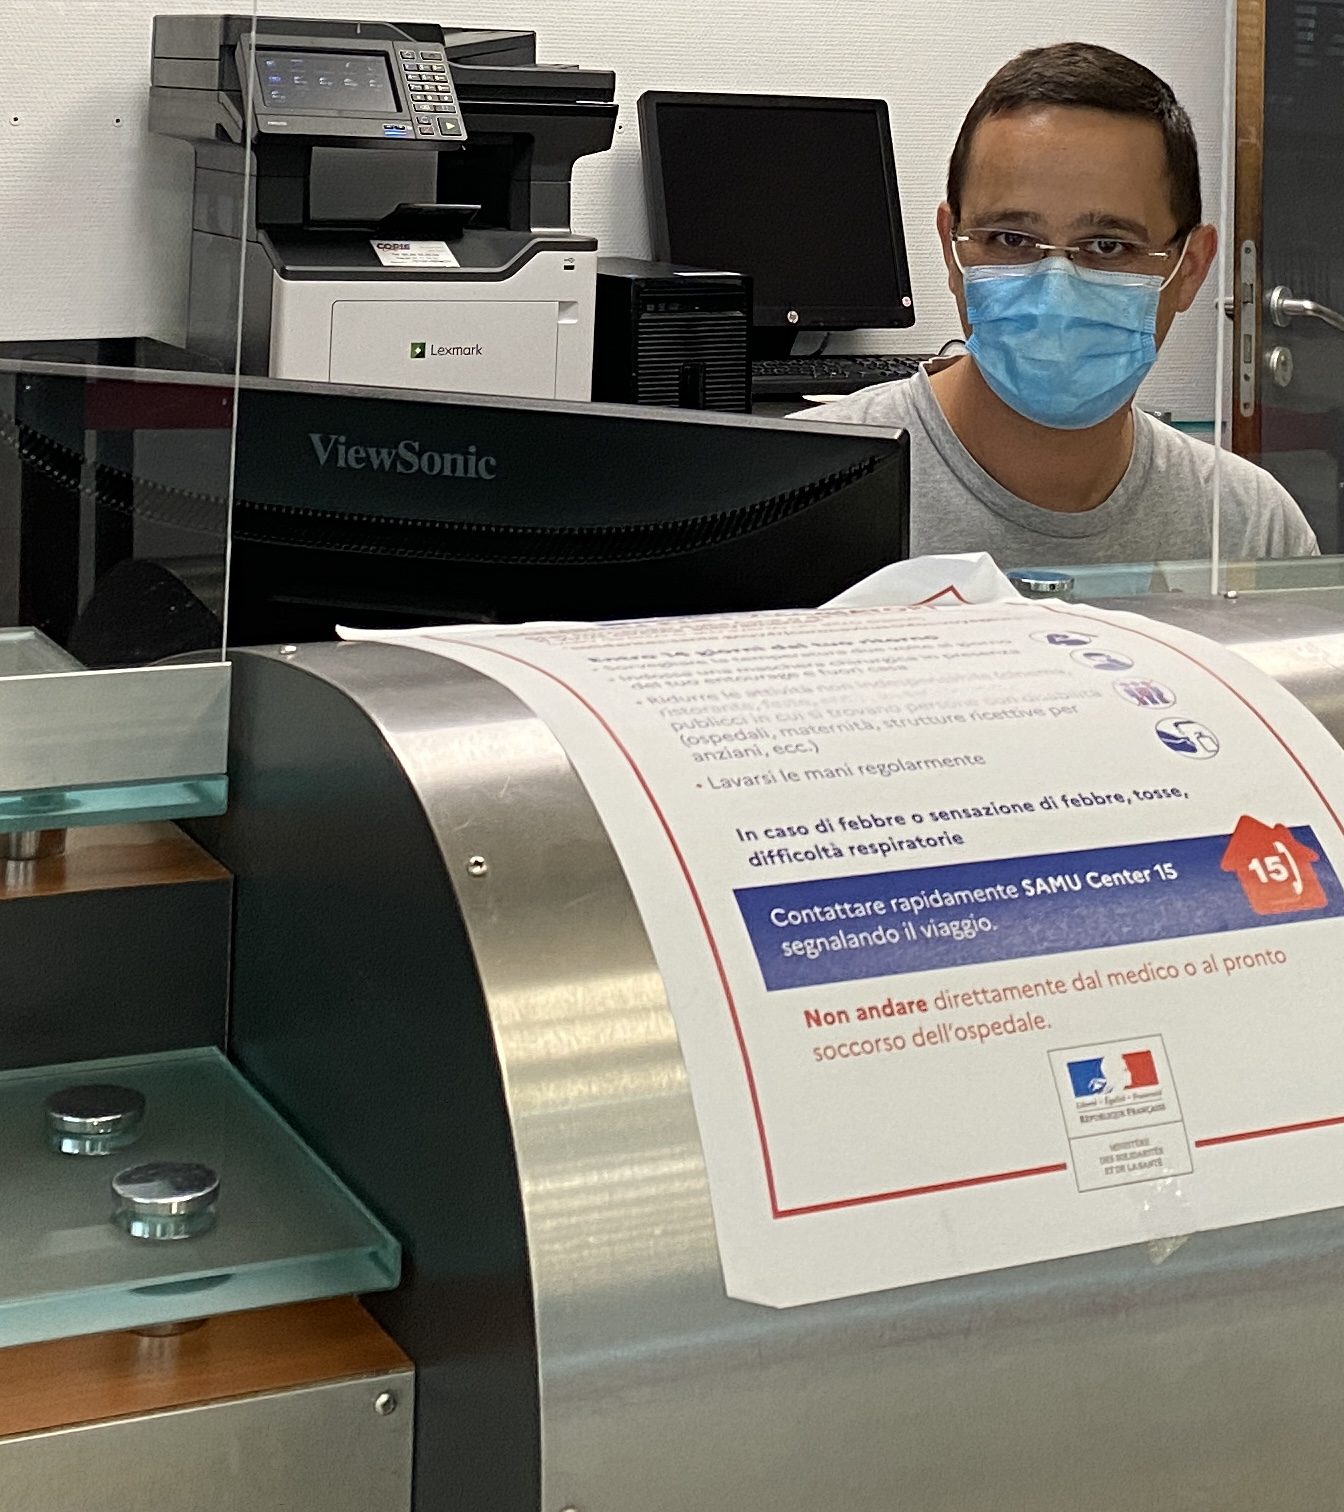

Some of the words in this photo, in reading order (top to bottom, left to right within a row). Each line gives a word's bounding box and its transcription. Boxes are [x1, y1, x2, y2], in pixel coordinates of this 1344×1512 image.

[430, 343, 483, 356] Lexmark
[309, 432, 498, 480] ViewSonic
[882, 713, 967, 730] strutture
[970, 705, 1047, 723] ricettive
[1049, 702, 1079, 718] per
[693, 743, 770, 763] anziani,
[706, 769, 777, 791] Lavarsi
[779, 768, 801, 784] le
[804, 761, 854, 781] mani
[857, 753, 987, 778] regolarmente
[736, 828, 758, 843] In
[763, 824, 810, 840] caso
[814, 818, 835, 834] di
[838, 813, 907, 832] febbre
[911, 813, 923, 824] o
[929, 801, 1035, 823] sensazione
[1039, 796, 1059, 810] di
[1060, 789, 1133, 809] febbre,
[1133, 786, 1189, 802] tosse,
[748, 842, 844, 868] difficoltà
[848, 830, 965, 858] respiratorie
[1248, 855, 1287, 885] 15
[770, 898, 887, 928] Contattare
[890, 882, 1019, 915] rapidamente
[1020, 871, 1083, 898] SAMU
[1086, 867, 1151, 889] Center
[1153, 862, 1179, 882] 15
[781, 924, 900, 959] segnalando
[905, 921, 917, 941] il
[919, 913, 998, 941] viaggio.
[803, 1004, 851, 1029] Non
[856, 995, 929, 1023] andare
[933, 975, 1068, 1012] direttamente
[1072, 970, 1104, 993] dal
[1107, 962, 1180, 989] medico
[1184, 963, 1197, 977] o
[1201, 955, 1219, 976] al
[1222, 948, 1288, 978] pronto
[812, 1035, 907, 1063] soccorso
